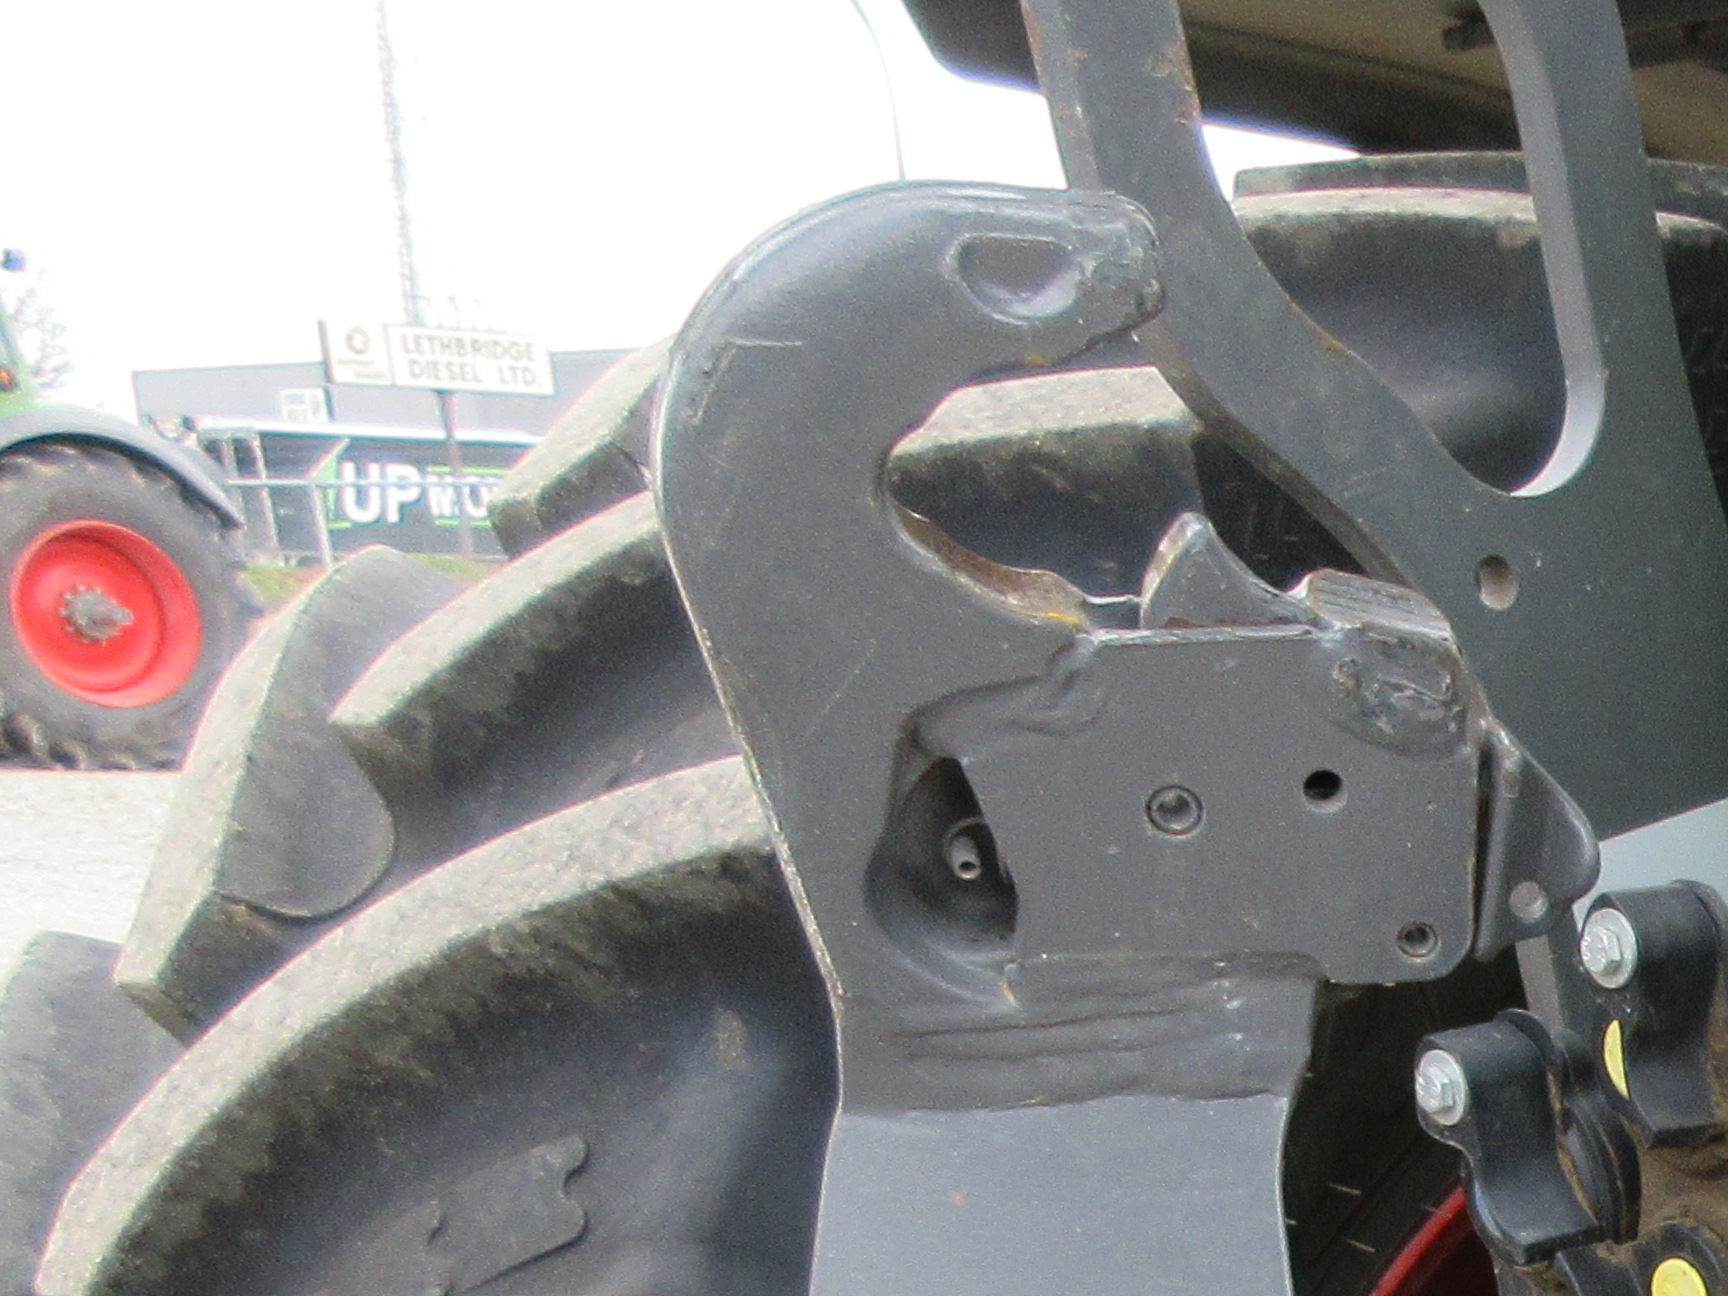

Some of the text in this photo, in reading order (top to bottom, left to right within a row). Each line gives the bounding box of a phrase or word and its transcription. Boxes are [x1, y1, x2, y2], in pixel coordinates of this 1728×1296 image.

[400, 333, 536, 362] LETHBRIDGE
[407, 358, 483, 383] DIESEL
[340, 461, 422, 523] UP
